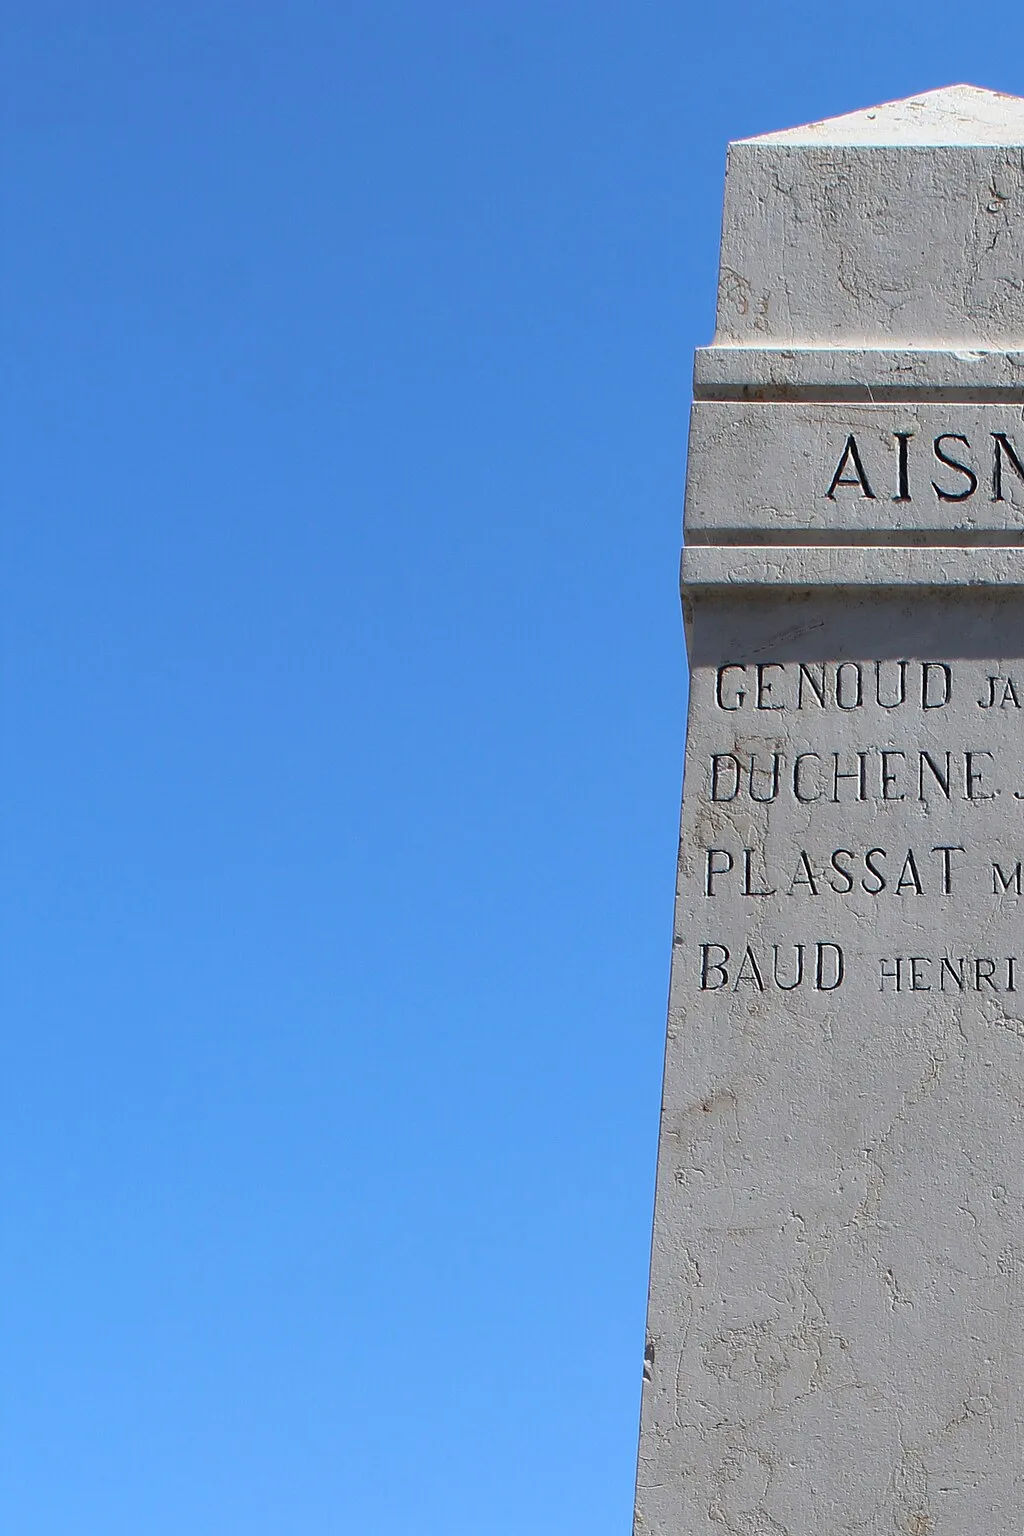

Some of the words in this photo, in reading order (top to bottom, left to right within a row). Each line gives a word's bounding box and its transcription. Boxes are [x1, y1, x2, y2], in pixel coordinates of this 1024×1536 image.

[715, 661, 953, 712] GENOUD
[709, 750, 995, 803] DUCHENE
[704, 847, 966, 898] PLASSAT
[698, 942, 845, 992] BAUD
[878, 957, 1018, 992] HENRI
